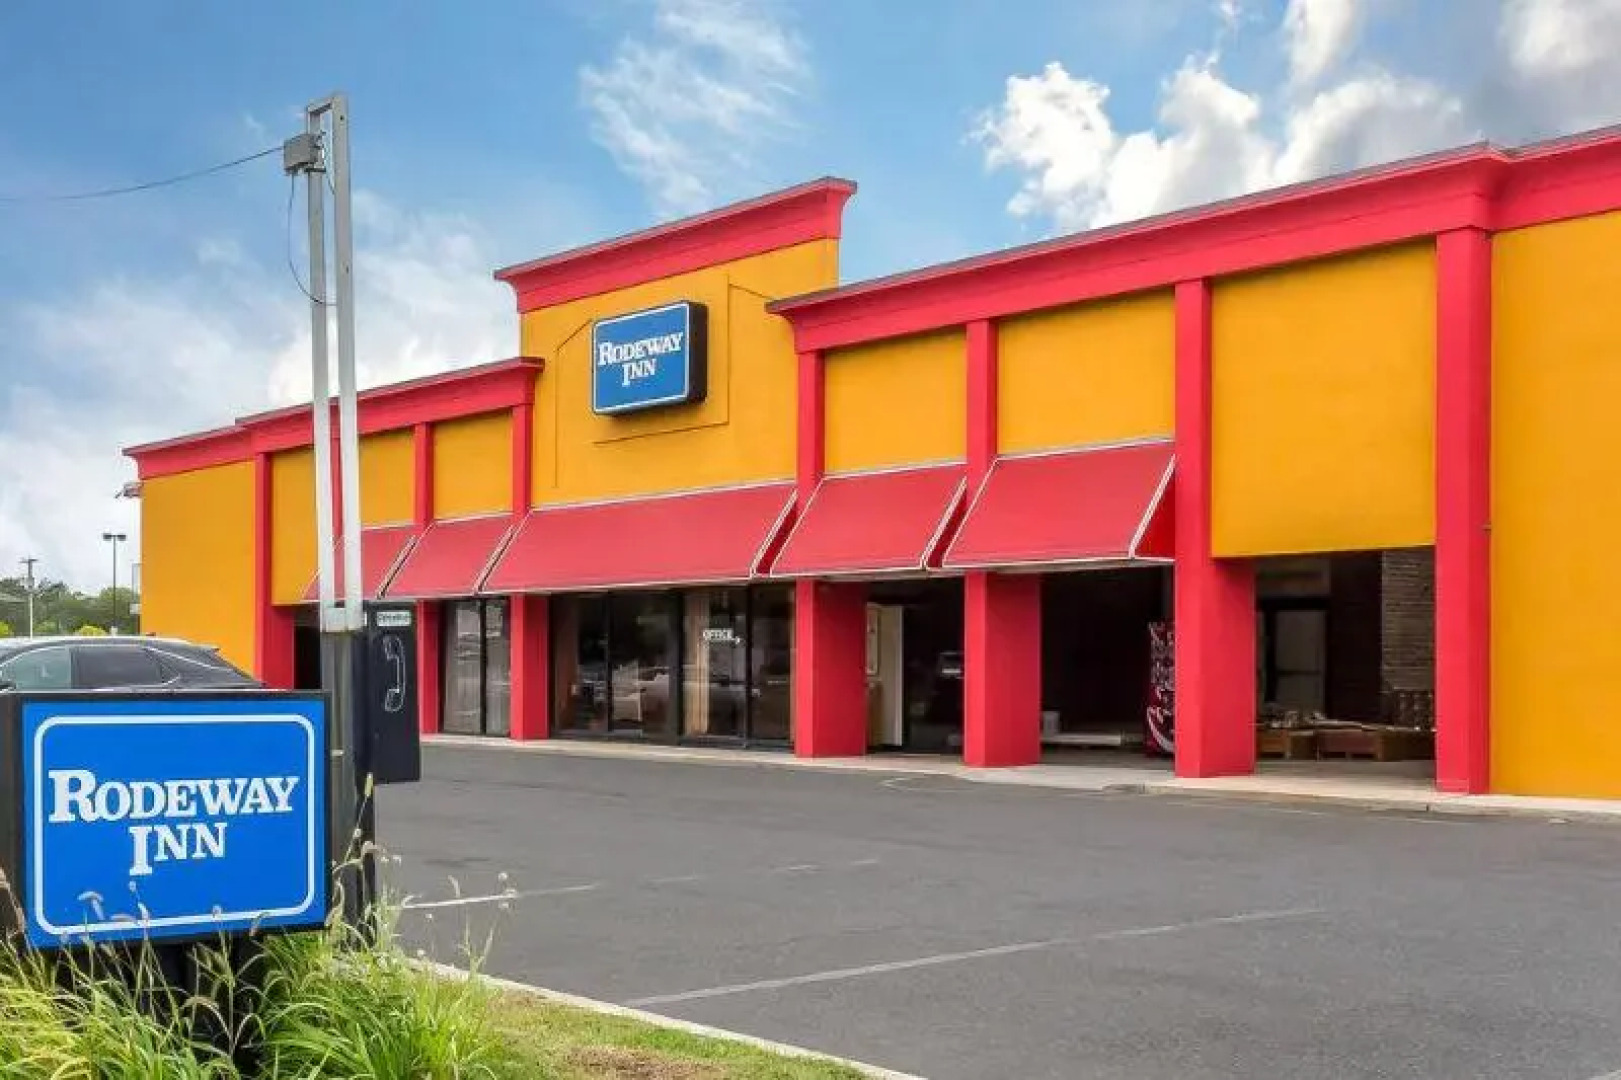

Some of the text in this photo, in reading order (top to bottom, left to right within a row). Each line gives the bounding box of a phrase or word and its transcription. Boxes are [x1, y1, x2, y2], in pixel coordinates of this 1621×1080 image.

[598, 331, 684, 366] RODEWAY
[621, 358, 657, 387] INN
[48, 769, 299, 822] RODEWAY
[128, 821, 228, 876] INN
